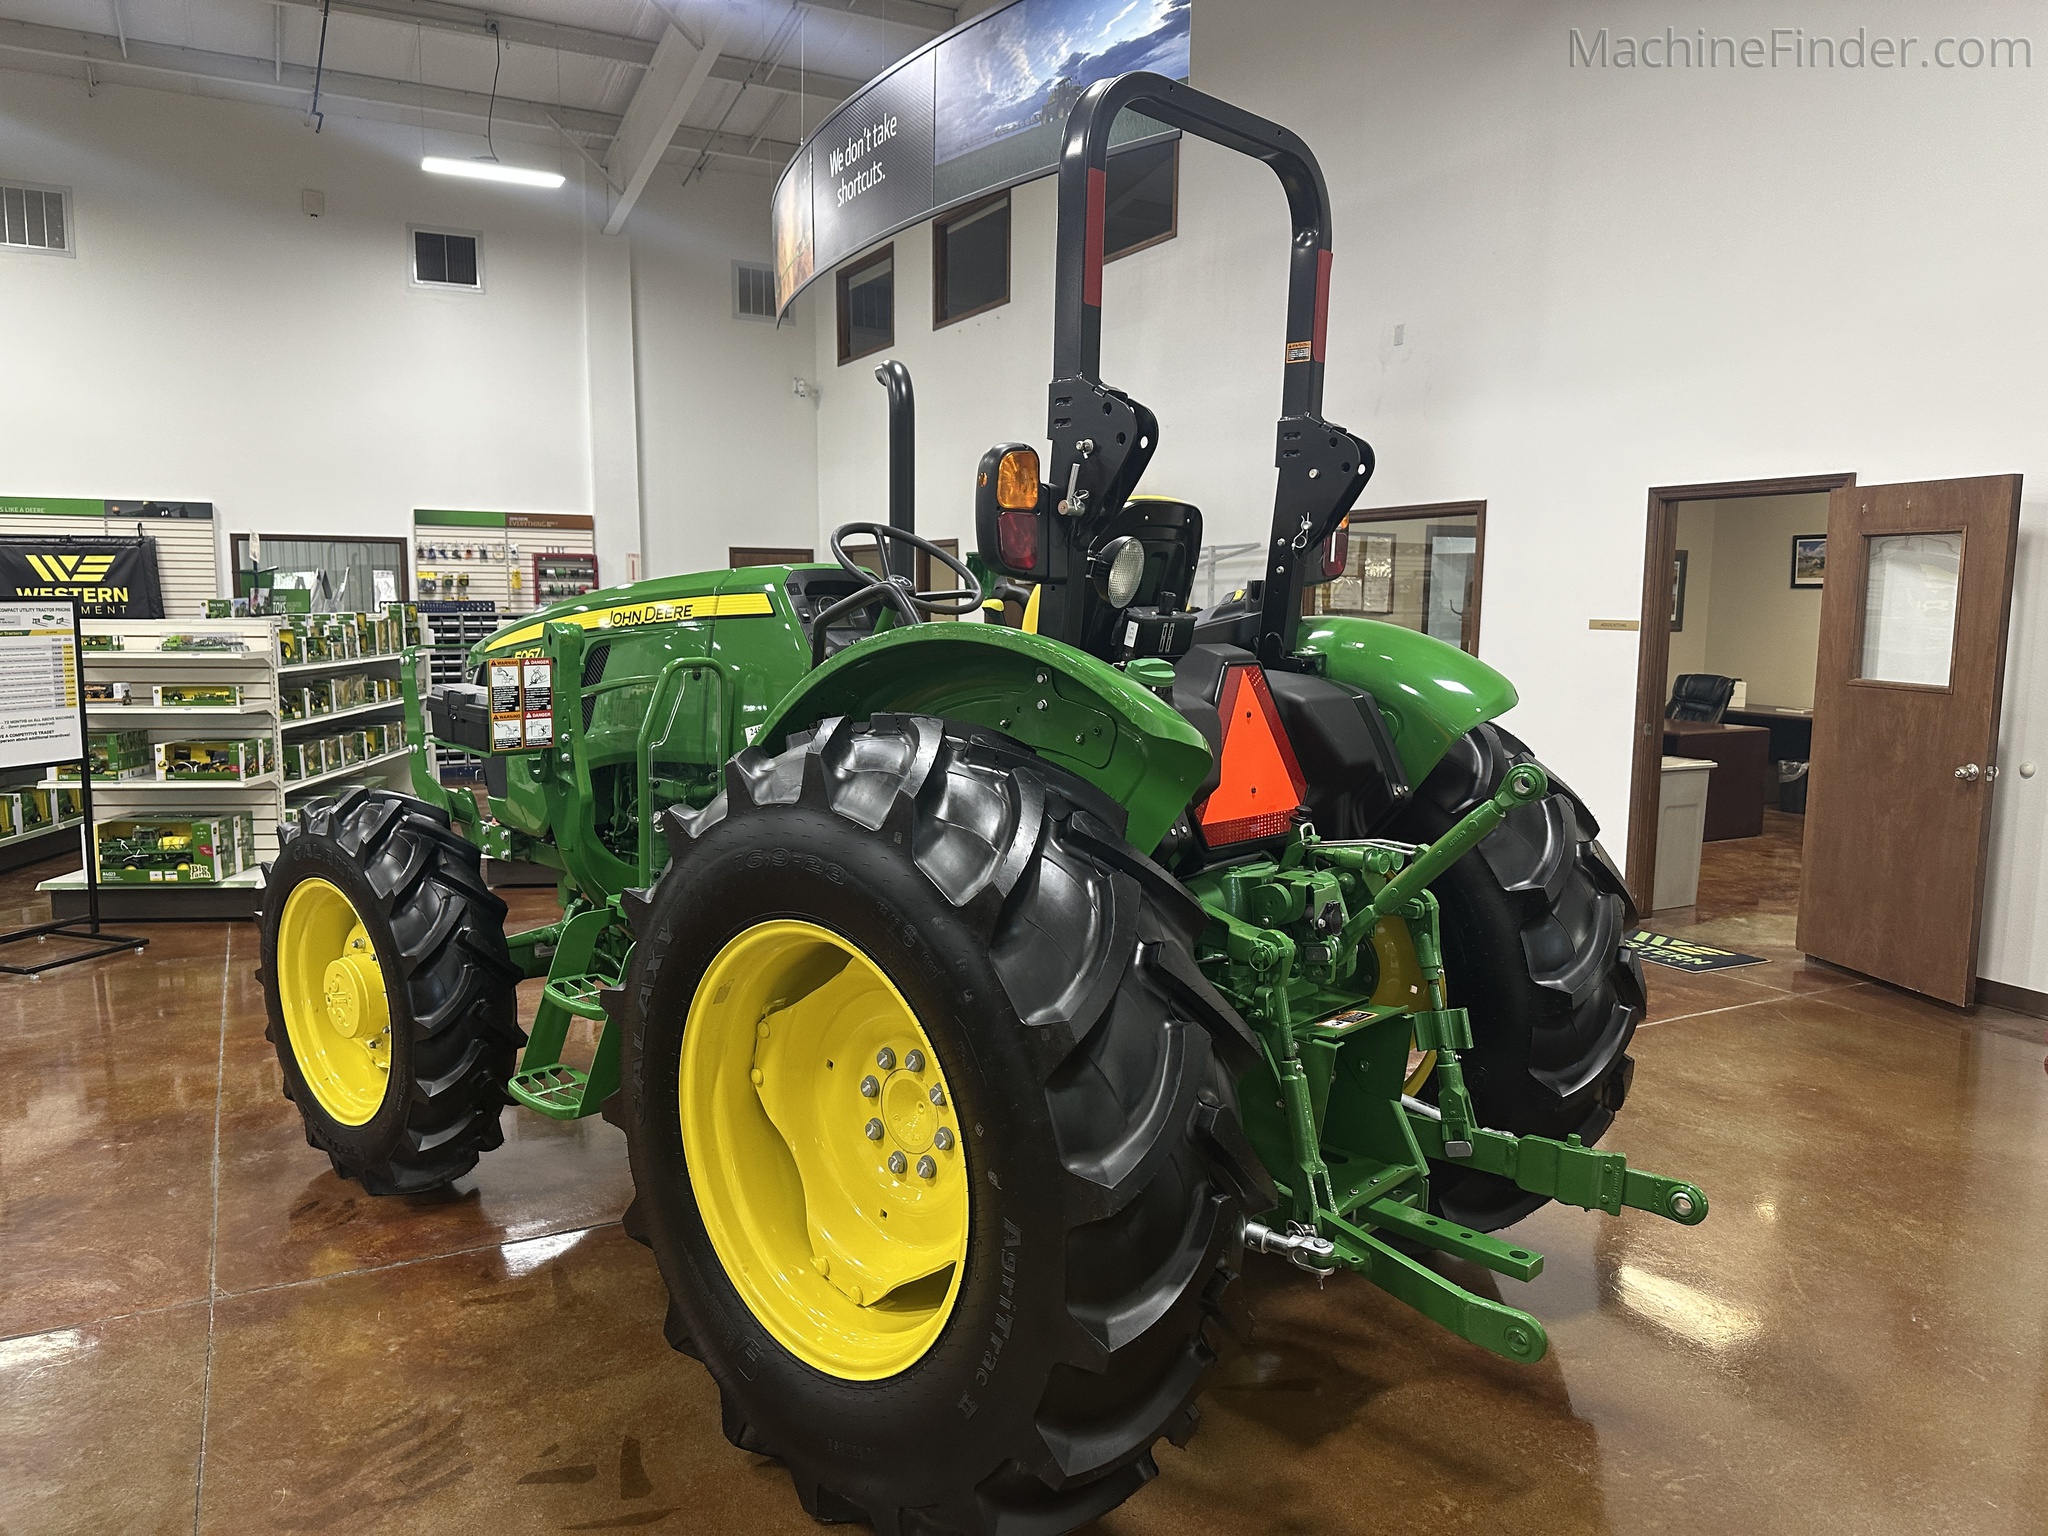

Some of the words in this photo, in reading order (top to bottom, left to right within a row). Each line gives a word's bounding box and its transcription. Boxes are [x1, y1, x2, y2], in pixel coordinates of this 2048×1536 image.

[829, 147, 844, 178] We
[845, 127, 871, 165] don't
[873, 112, 898, 148] take
[837, 160, 886, 207] shortcuts.
[272, 601, 287, 614] TOYS
[605, 610, 642, 626] JOHN
[644, 604, 694, 622] DEERE
[514, 647, 545, 659] 5067
[632, 917, 675, 1127] GALAXY
